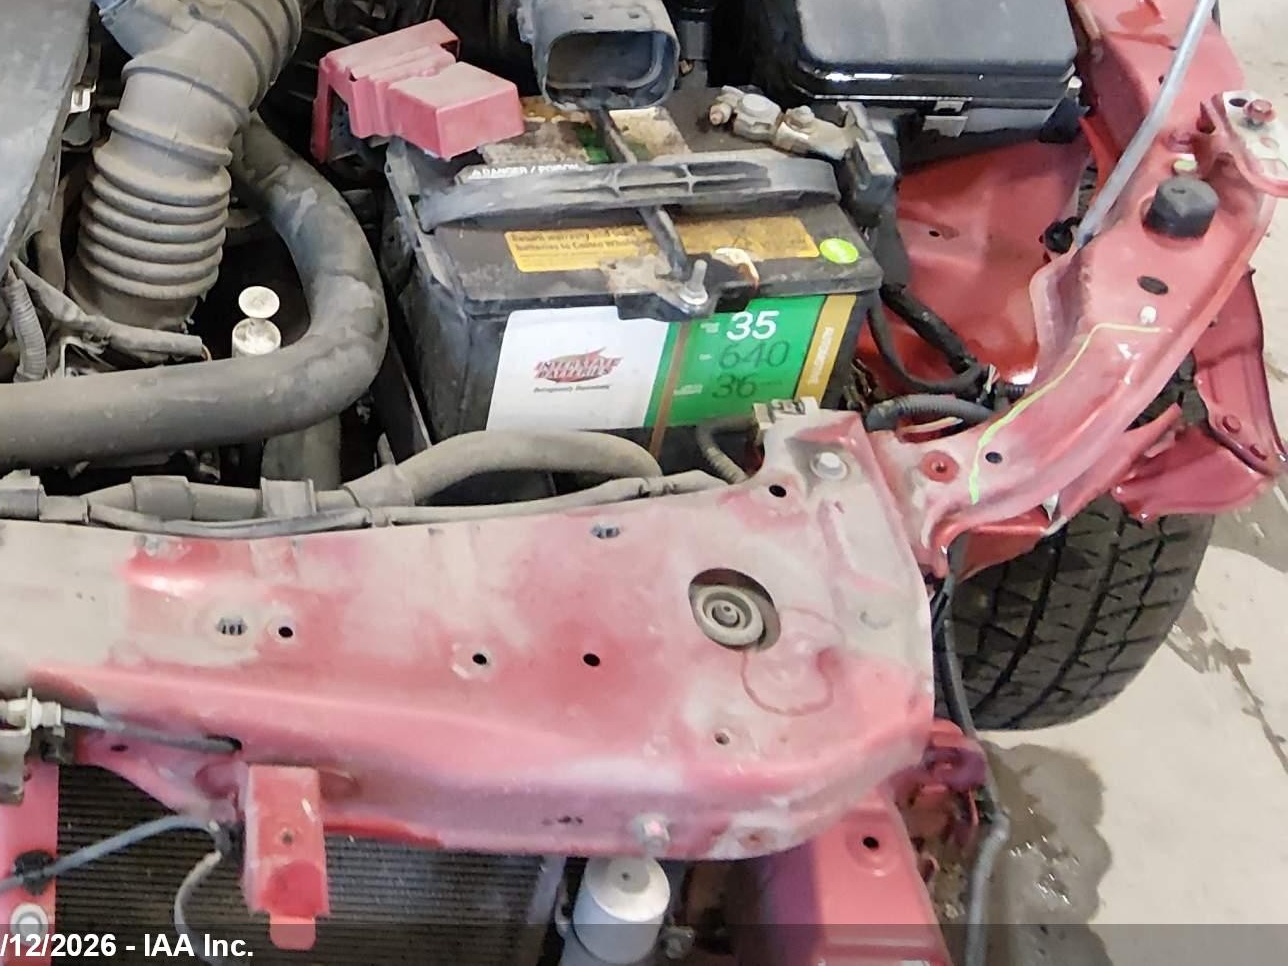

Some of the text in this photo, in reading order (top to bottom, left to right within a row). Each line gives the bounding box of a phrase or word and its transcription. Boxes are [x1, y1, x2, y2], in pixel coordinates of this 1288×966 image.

[726, 310, 780, 341] 35
[534, 357, 622, 370] INTERSTATE
[718, 340, 790, 370] 640
[534, 368, 609, 379] BATTERIES
[712, 372, 758, 399] 36
